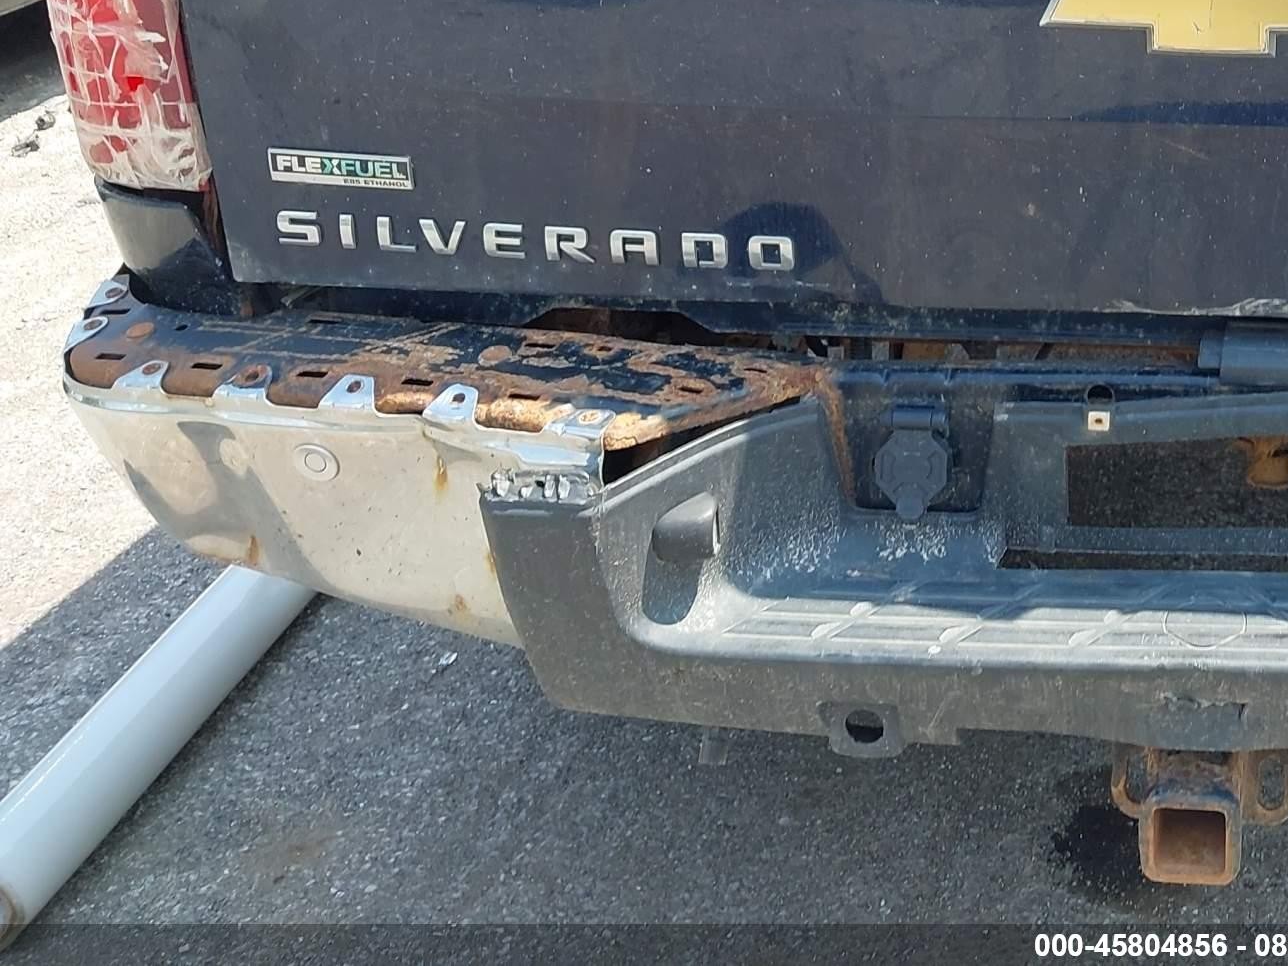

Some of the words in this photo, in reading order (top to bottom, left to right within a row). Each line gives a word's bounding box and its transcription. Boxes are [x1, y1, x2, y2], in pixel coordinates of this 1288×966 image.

[275, 155, 407, 179] FLEXFUEL
[363, 179, 408, 188] ETHANOL
[276, 209, 797, 271] SILVERADO
